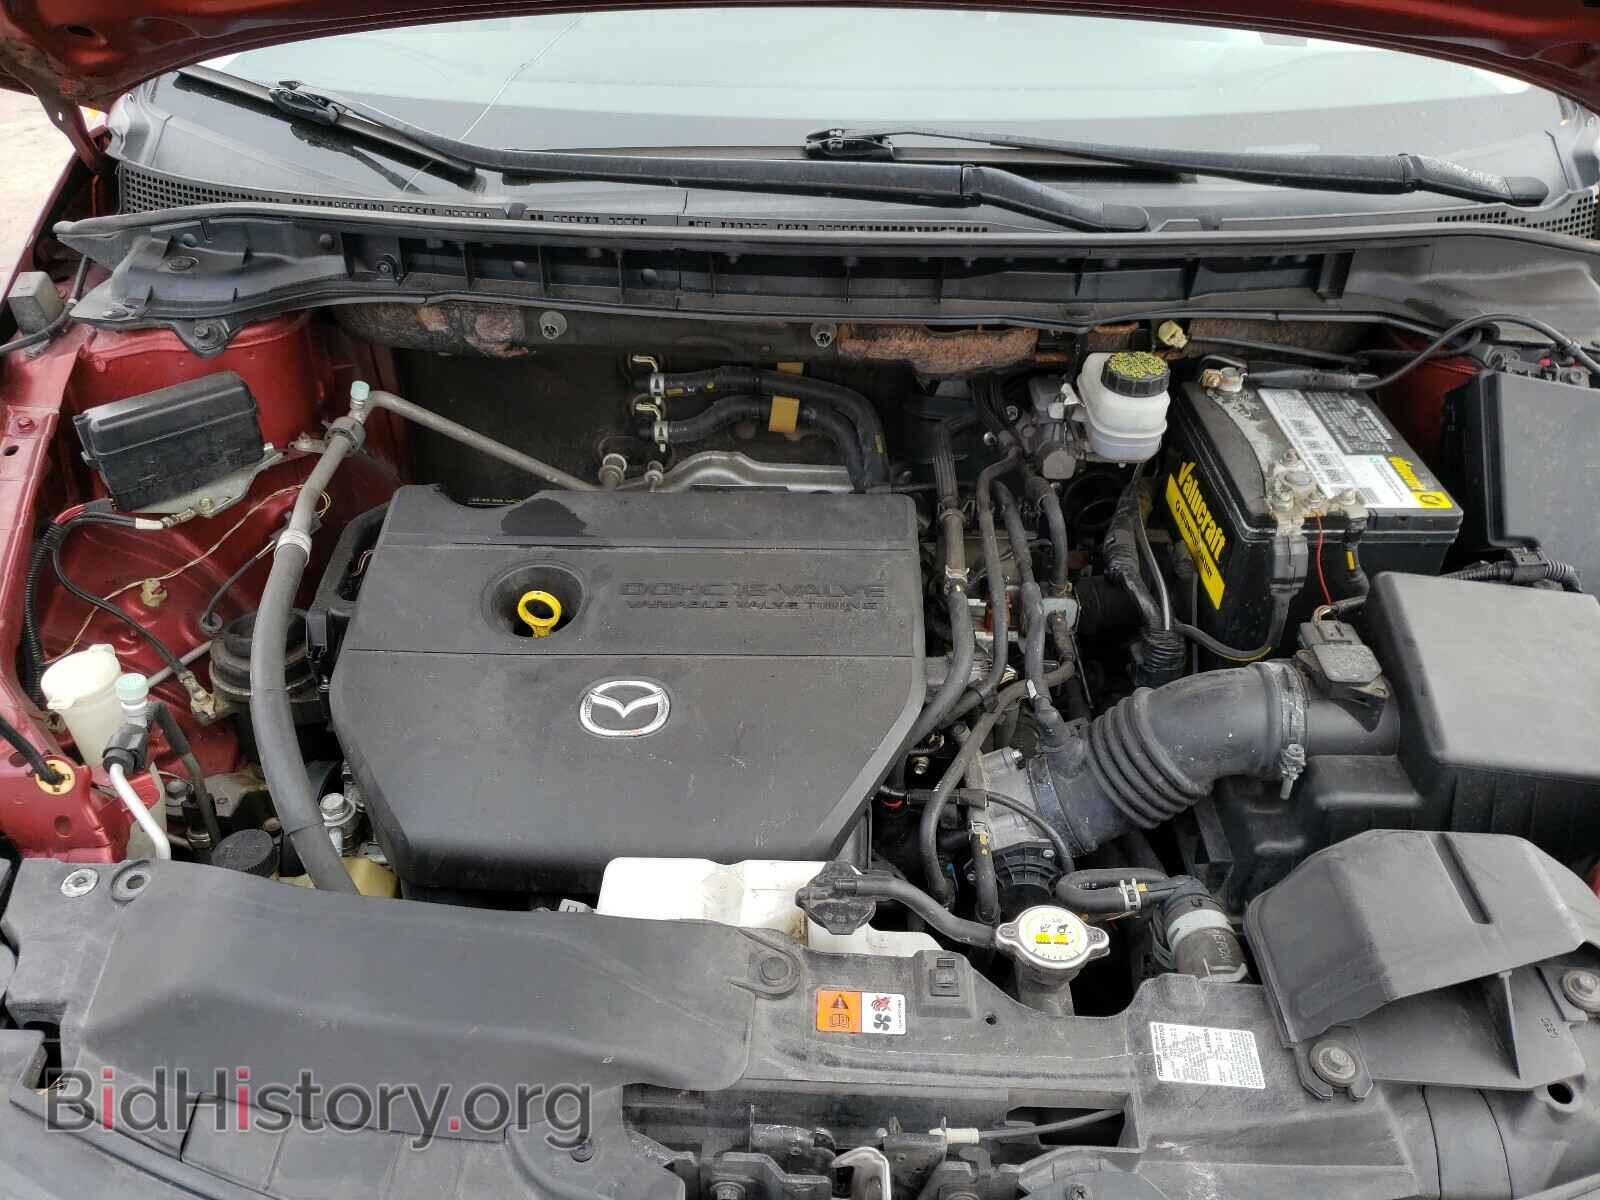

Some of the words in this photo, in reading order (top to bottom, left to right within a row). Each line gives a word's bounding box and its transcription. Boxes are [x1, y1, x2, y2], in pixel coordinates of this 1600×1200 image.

[1178, 462, 1226, 561] Valucraft
[622, 583, 730, 596] DOHC
[625, 600, 729, 608] VARIABLE
[737, 600, 799, 609] VALVE
[807, 600, 881, 609] TIMING
